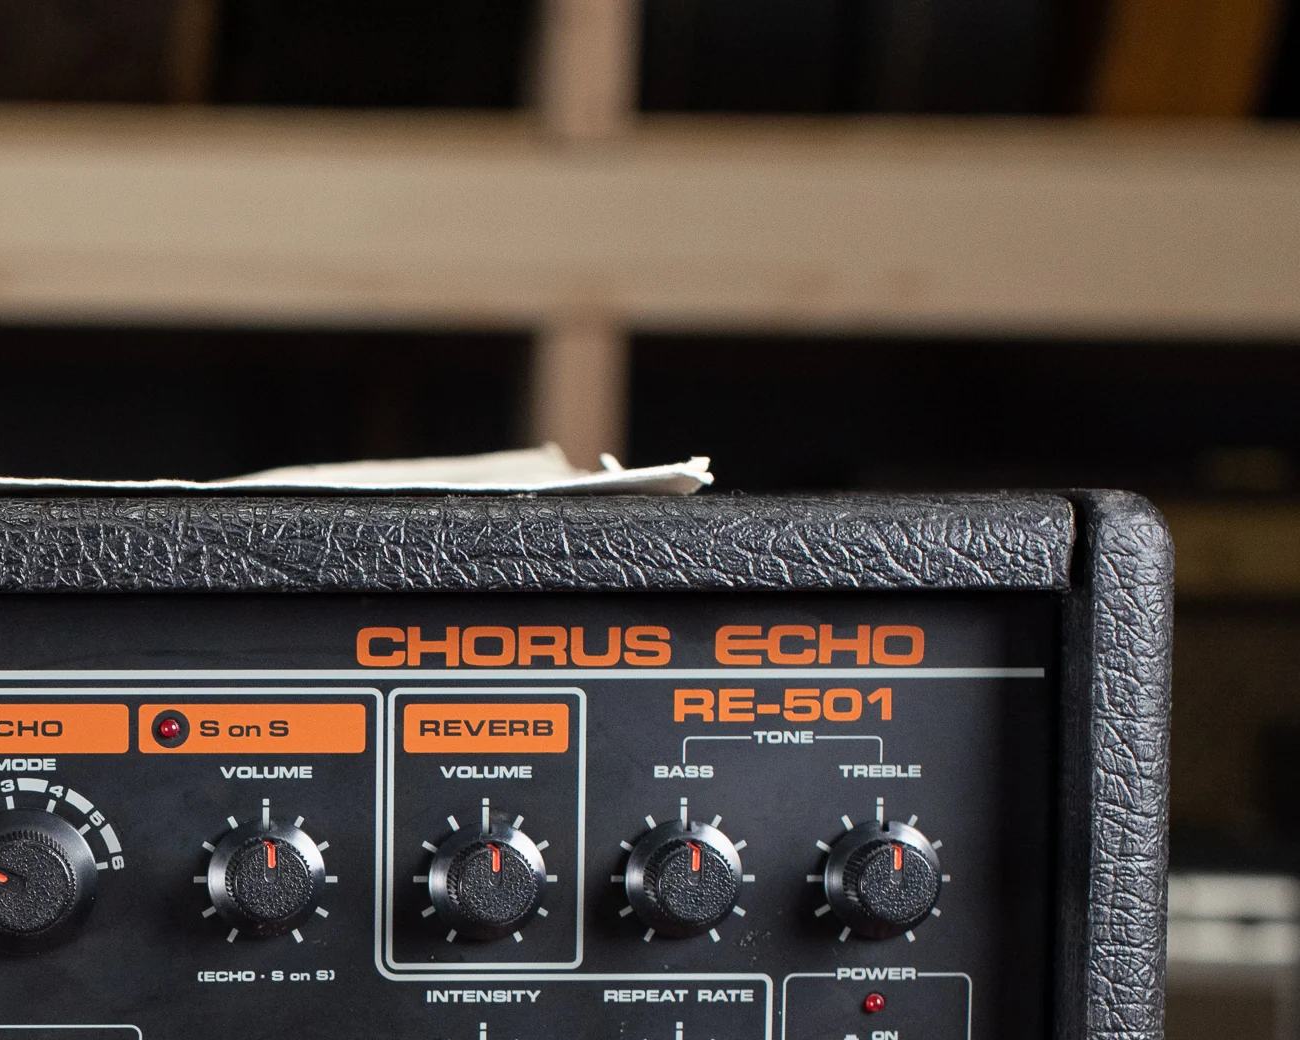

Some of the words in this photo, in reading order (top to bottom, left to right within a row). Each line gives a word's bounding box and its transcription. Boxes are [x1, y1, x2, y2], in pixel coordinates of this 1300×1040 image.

[356, 625, 672, 667] CHORUS
[715, 624, 925, 666] ECHO
[673, 687, 892, 722] RE-501
[200, 720, 220, 737] S
[228, 723, 261, 737] on
[269, 720, 289, 737] S
[419, 719, 554, 737] REVERB
[753, 731, 814, 744] TONE
[220, 766, 313, 779] VOLUME
[440, 765, 533, 779] VOLUME
[653, 765, 714, 779] BASS
[839, 764, 922, 778] TREBLE
[1, 779, 15, 793] 3
[49, 785, 64, 798] 4
[90, 810, 105, 827] 5
[111, 855, 125, 870] 6
[197, 971, 256, 982] (ECHO
[271, 971, 284, 981] S
[290, 973, 310, 981] on
[316, 970, 335, 981] S)
[836, 968, 916, 980] POWER
[427, 990, 541, 1003] INTENSITY
[603, 990, 688, 1002] REPEAT
[697, 990, 754, 1002] RATE
[871, 1031, 898, 1040] ON
